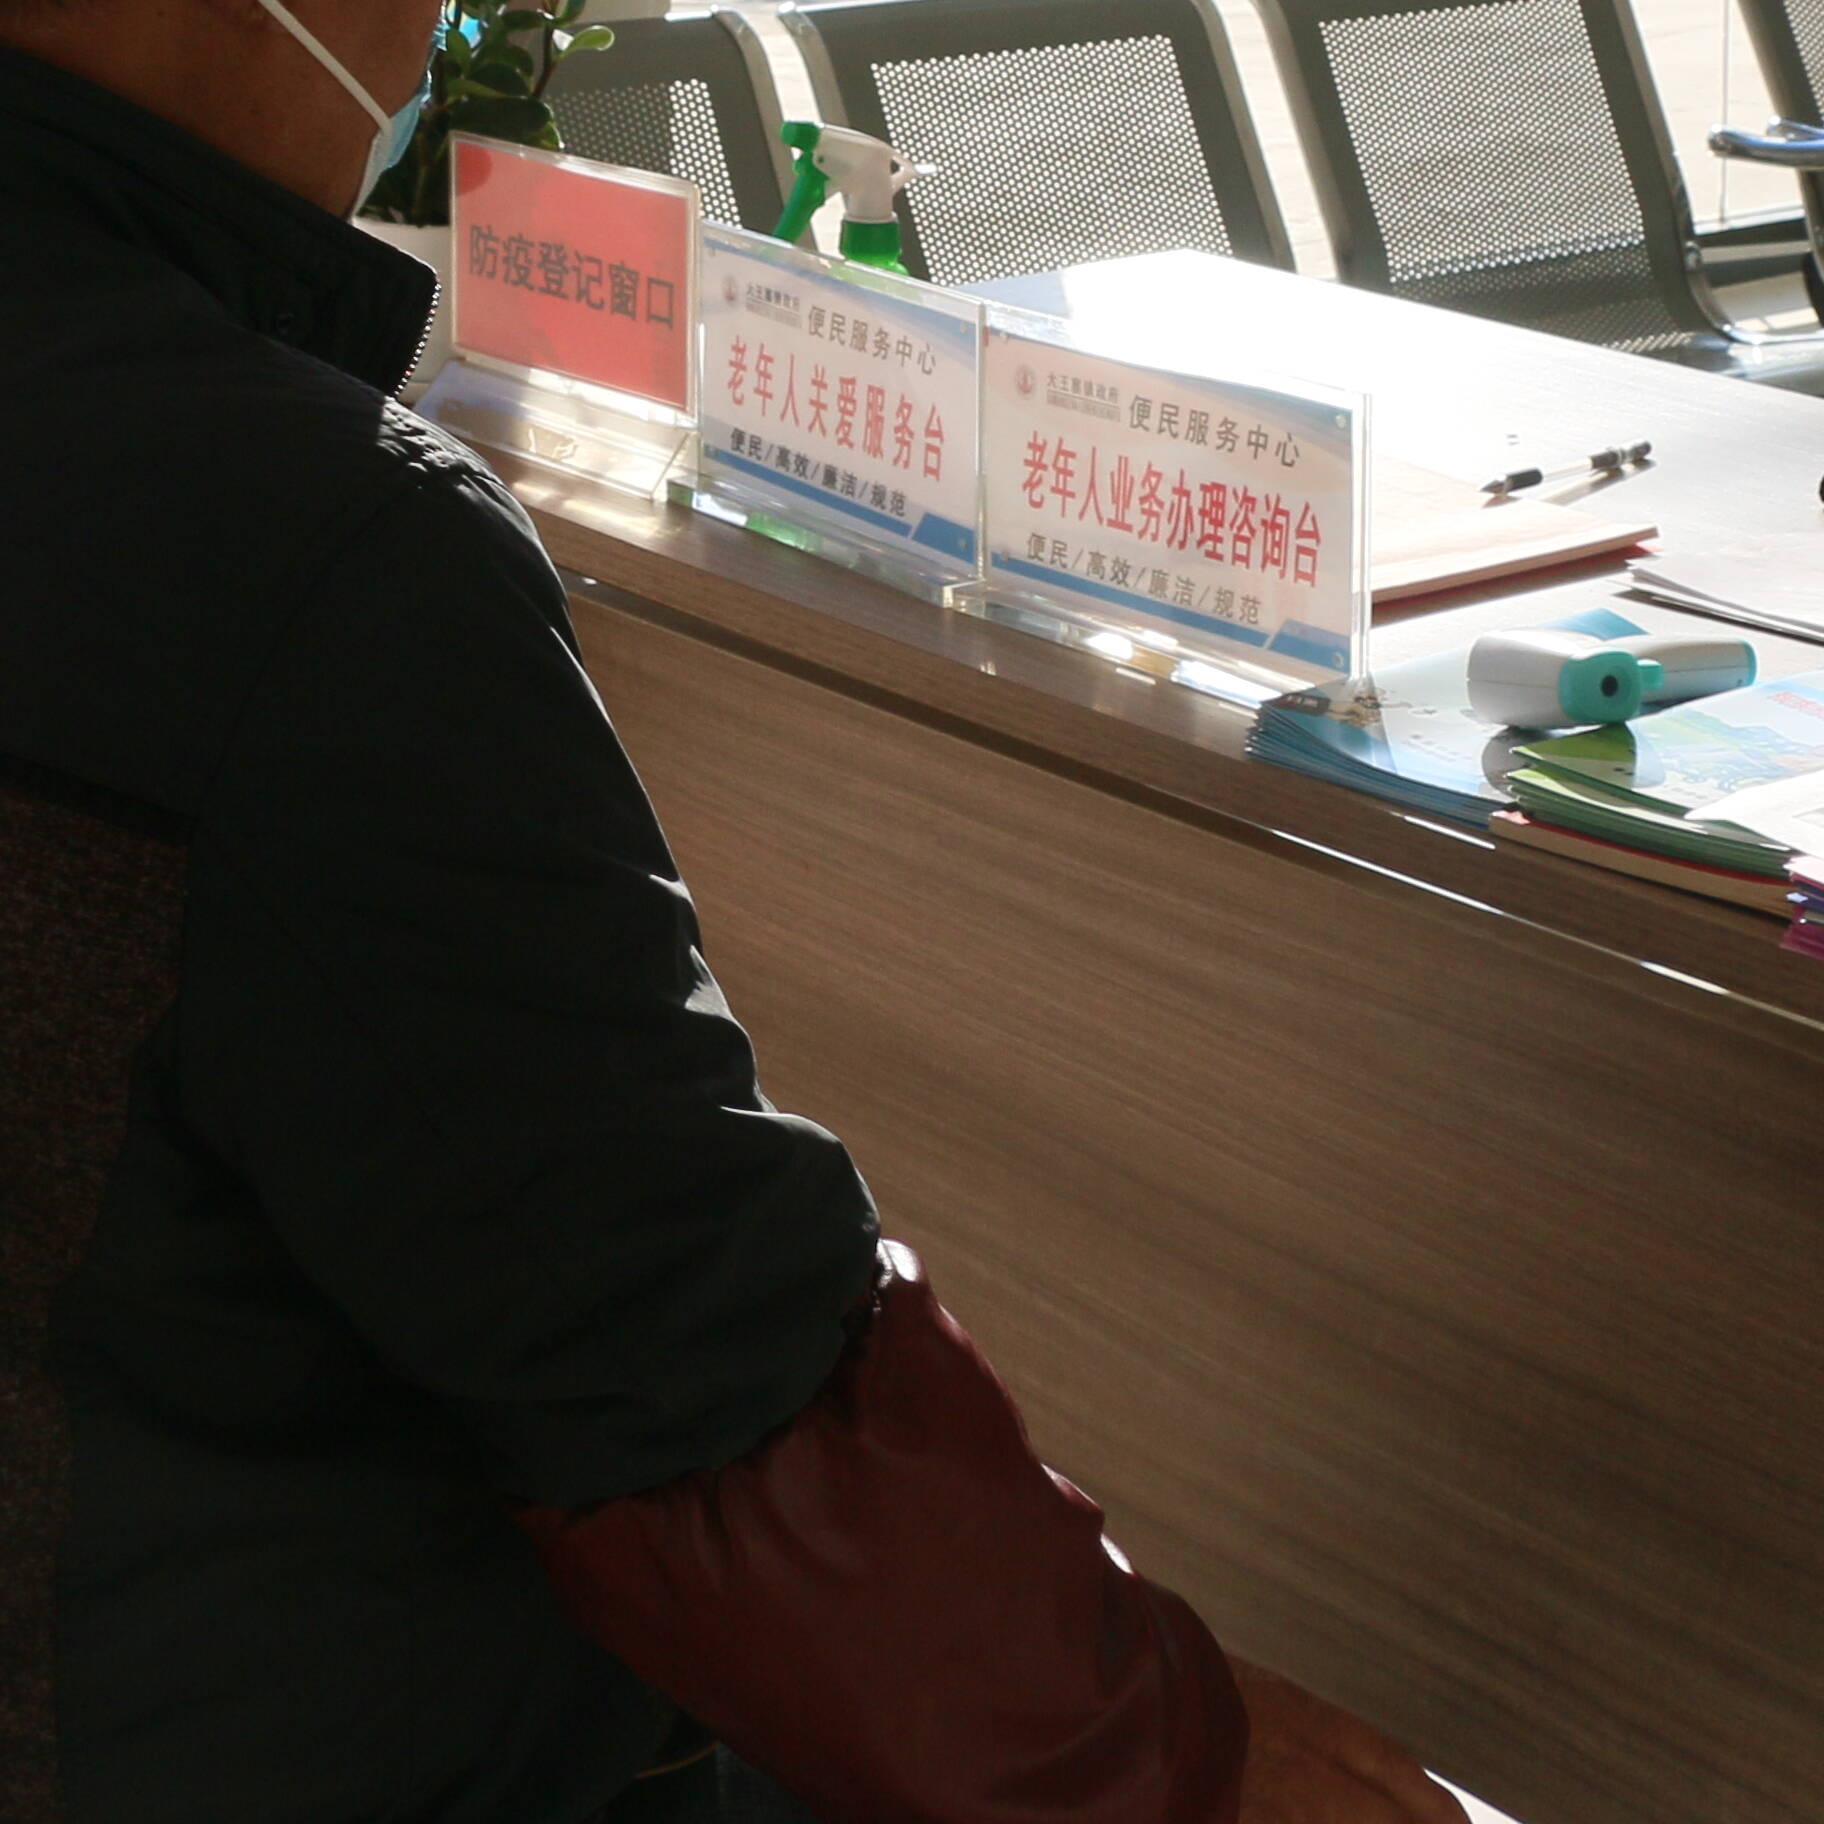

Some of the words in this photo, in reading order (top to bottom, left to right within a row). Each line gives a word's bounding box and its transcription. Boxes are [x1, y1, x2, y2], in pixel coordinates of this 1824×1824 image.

[469, 224, 674, 330] 防疫登记窗口
[808, 305, 937, 376] 便民服务中心
[727, 334, 945, 482] 老年人关爱服务台
[1129, 394, 1301, 468] 便民服务中心
[729, 427, 909, 518] 便民/高效/廉洁/规范
[1022, 430, 1322, 588] 老年人业务办理咨询台
[1025, 532, 1262, 626] 便民/高效/廉洁/规范
